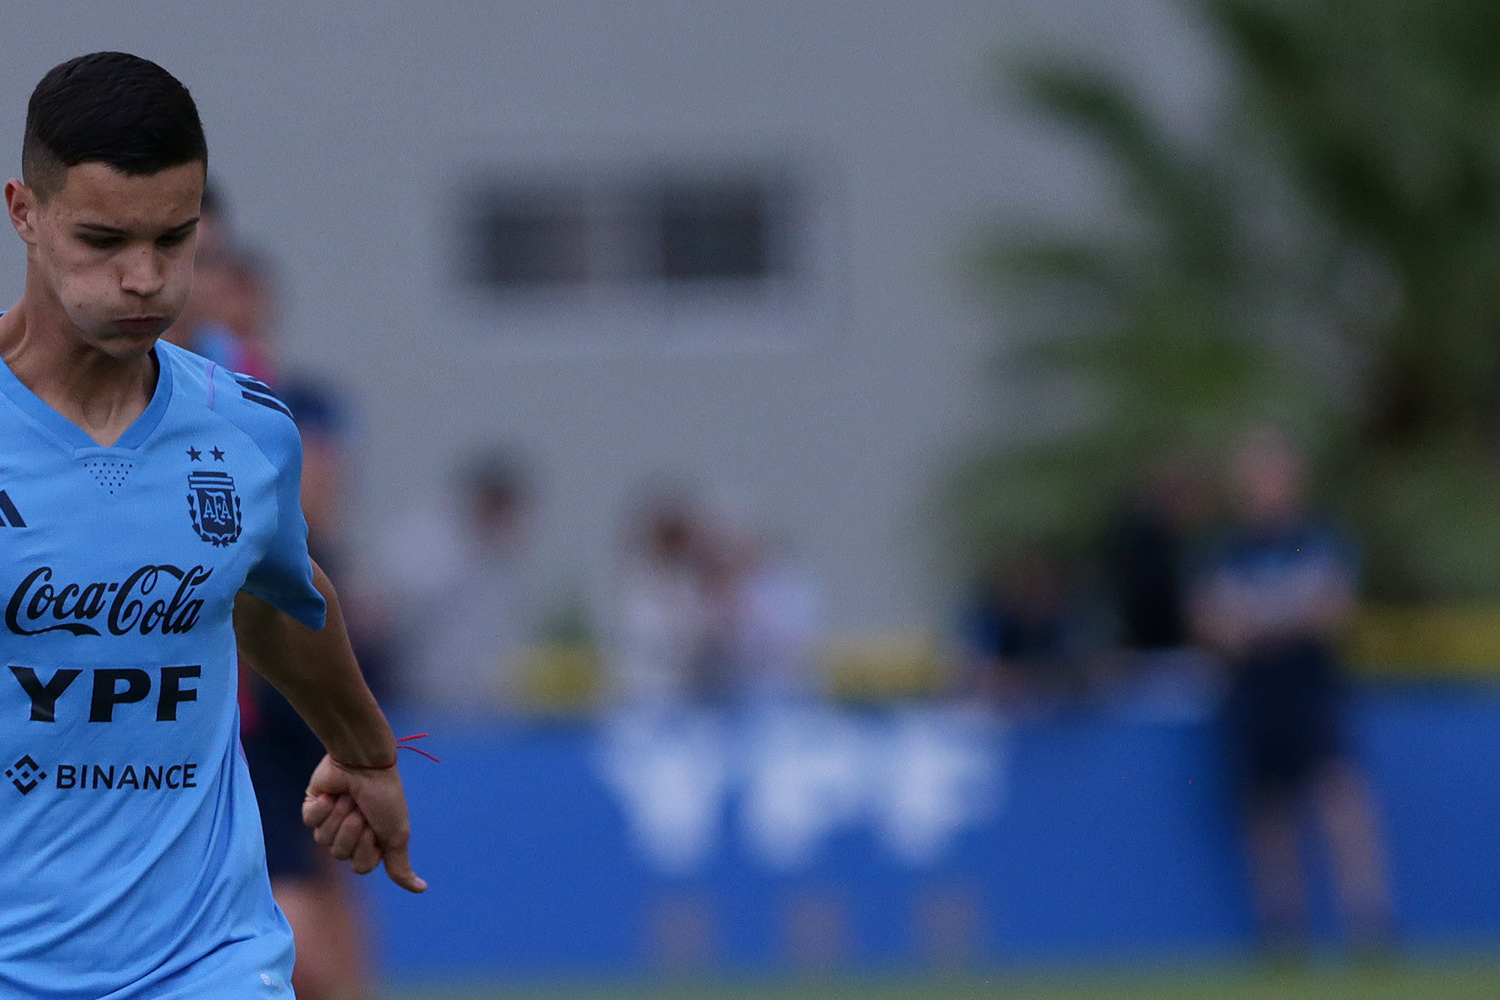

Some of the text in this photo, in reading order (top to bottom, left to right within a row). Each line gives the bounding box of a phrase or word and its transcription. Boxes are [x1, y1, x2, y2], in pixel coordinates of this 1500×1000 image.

[203, 490, 233, 526] AFA
[4, 564, 214, 637] Coca-Cola
[7, 664, 202, 723] YPF
[55, 763, 198, 790] BINANCE
[595, 708, 1005, 868] YPF
